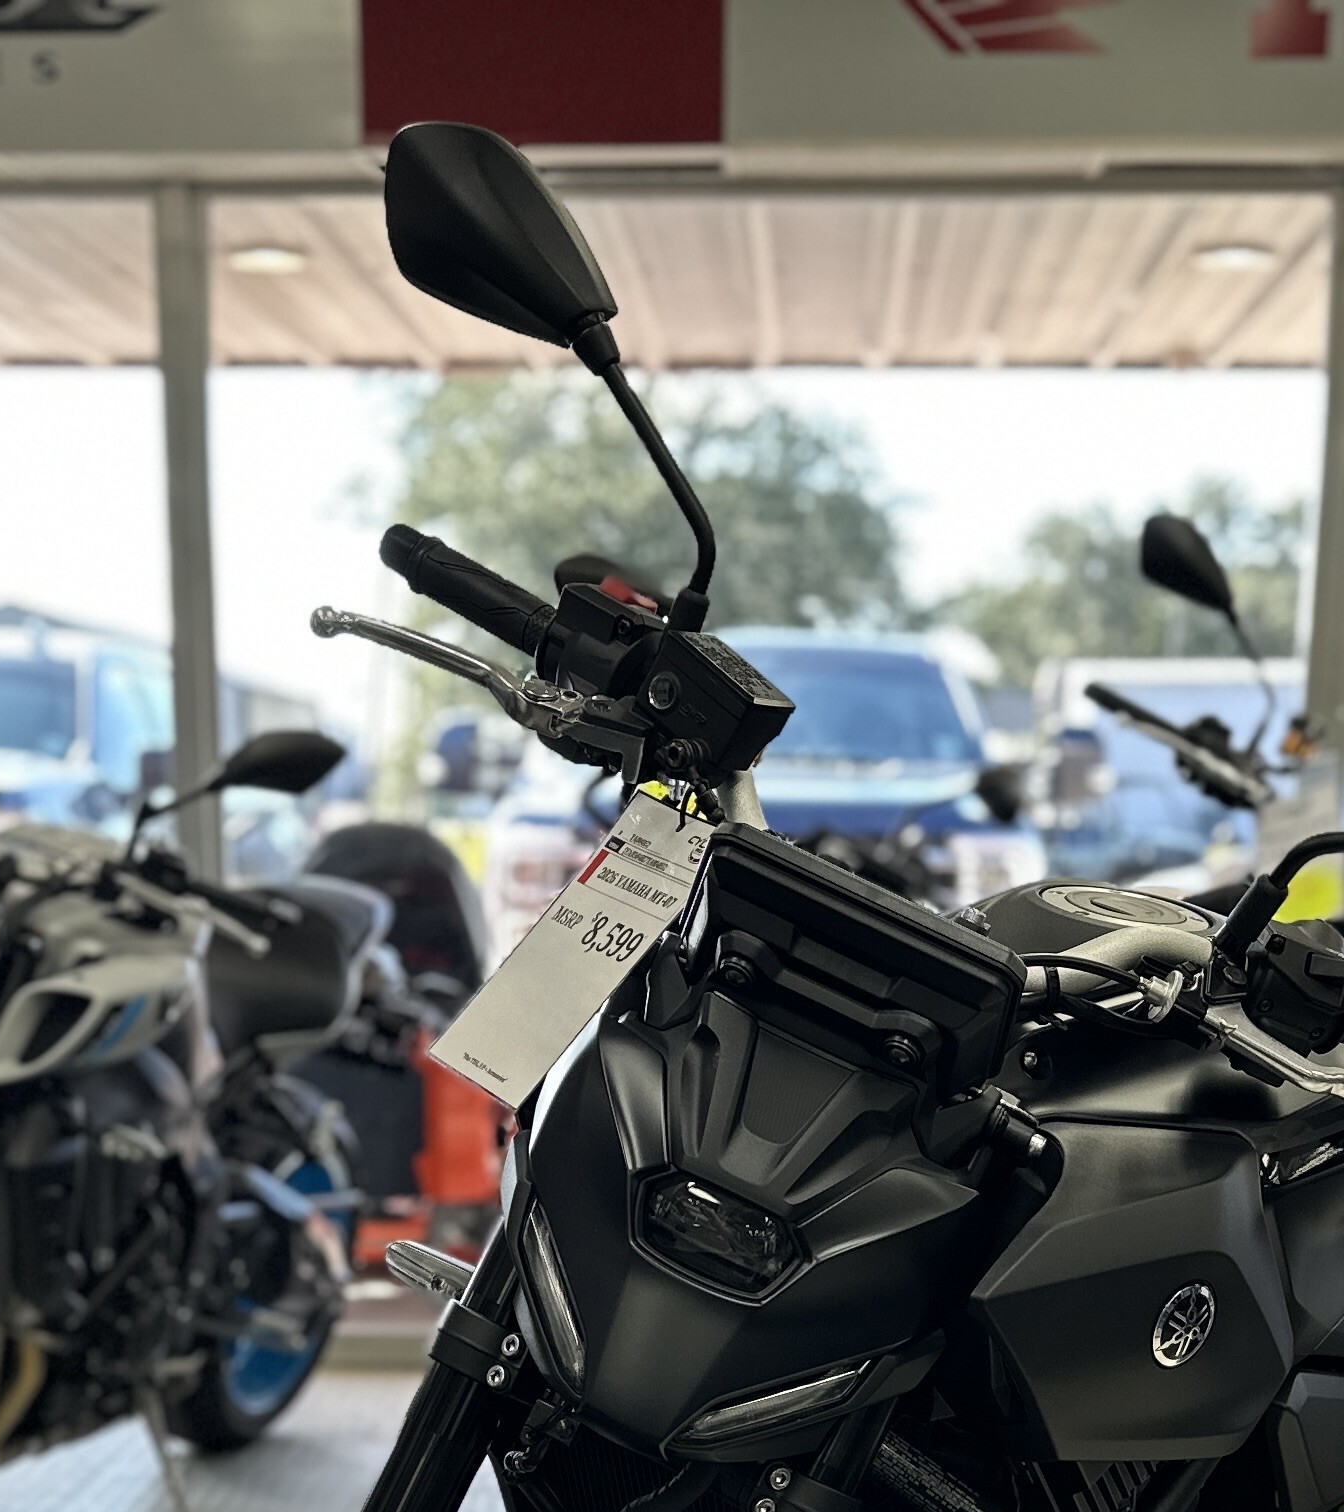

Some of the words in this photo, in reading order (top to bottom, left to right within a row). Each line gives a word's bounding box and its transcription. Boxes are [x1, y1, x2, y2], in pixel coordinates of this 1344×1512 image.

[615, 874, 653, 899] YAMAHA
[648, 886, 678, 908] MT-07
[551, 905, 584, 929] MSRP
[580, 911, 645, 962] $8,599
